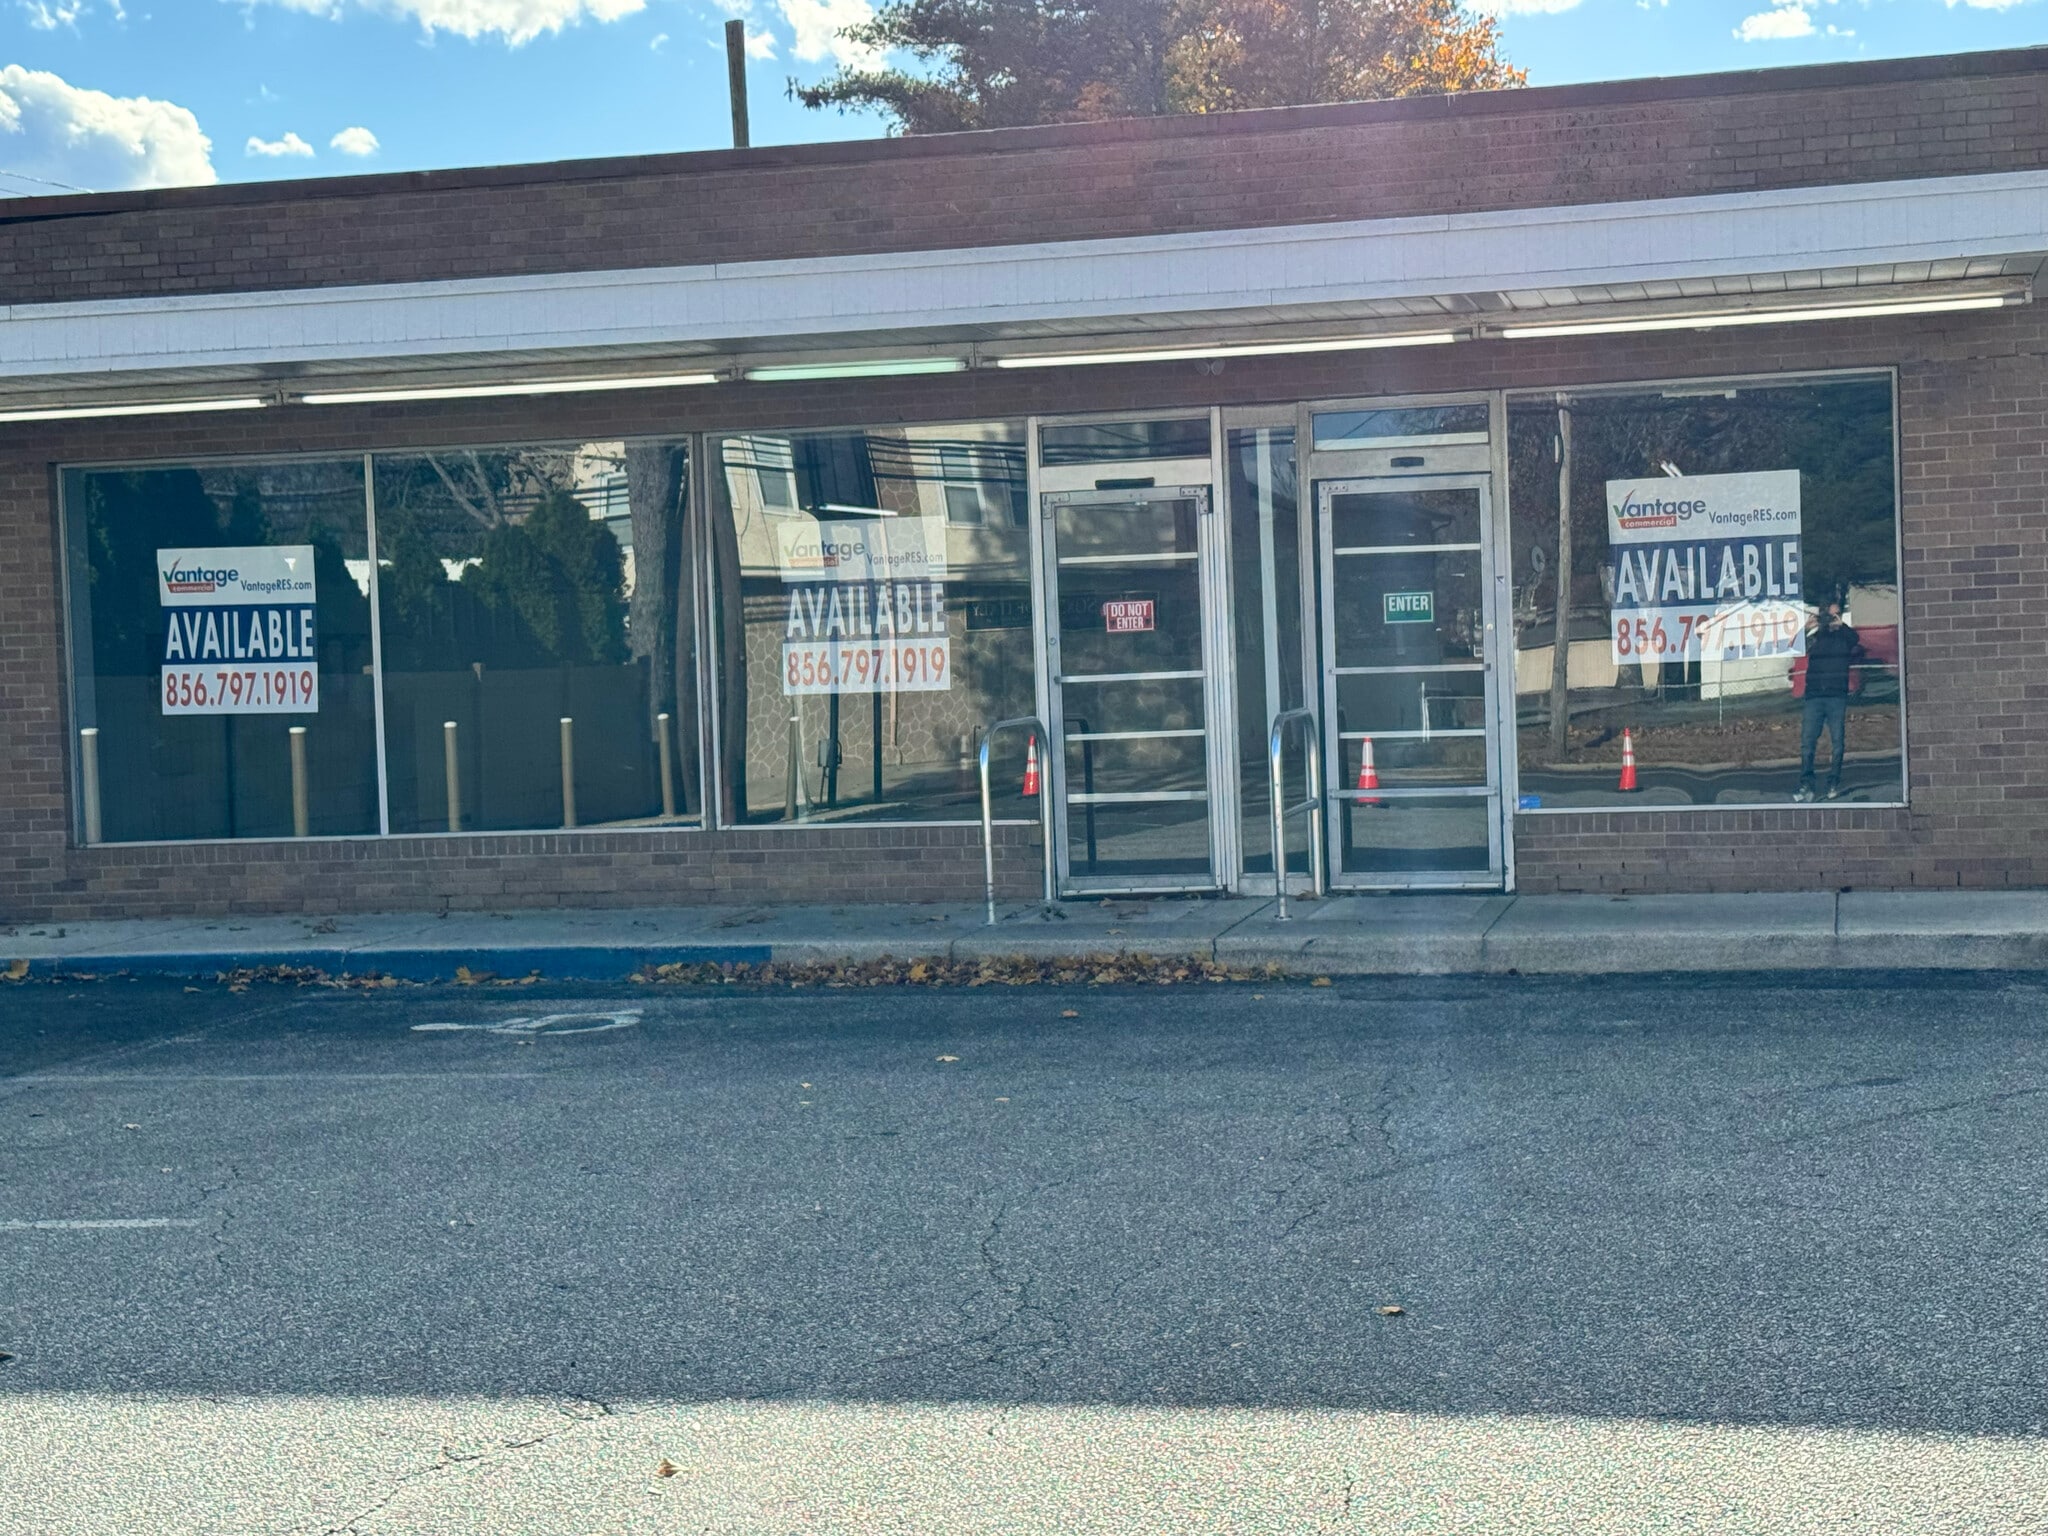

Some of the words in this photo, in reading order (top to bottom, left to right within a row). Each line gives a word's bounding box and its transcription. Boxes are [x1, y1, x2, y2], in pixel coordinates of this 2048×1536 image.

[1613, 488, 1706, 520] Vantage
[1709, 508, 1797, 526] VantageRES.com
[1625, 517, 1675, 528] commercial
[783, 528, 865, 561] Vantage
[866, 551, 944, 568] VantageRES.com
[163, 557, 239, 587] Vantage
[240, 579, 312, 594] VantageRES.com
[1616, 542, 1799, 603] AVAILABLE
[787, 583, 945, 638] AVAILABLE
[1111, 604, 1125, 617] DO
[1127, 603, 1148, 616] NOT
[1388, 595, 1429, 611] ENTER
[166, 609, 314, 659] AVAILABLE
[1117, 616, 1144, 629] ENTER
[1617, 611, 1799, 656] 856.797.1919
[787, 646, 945, 686] 856.797.1919
[166, 670, 313, 706] 856.797.1919
